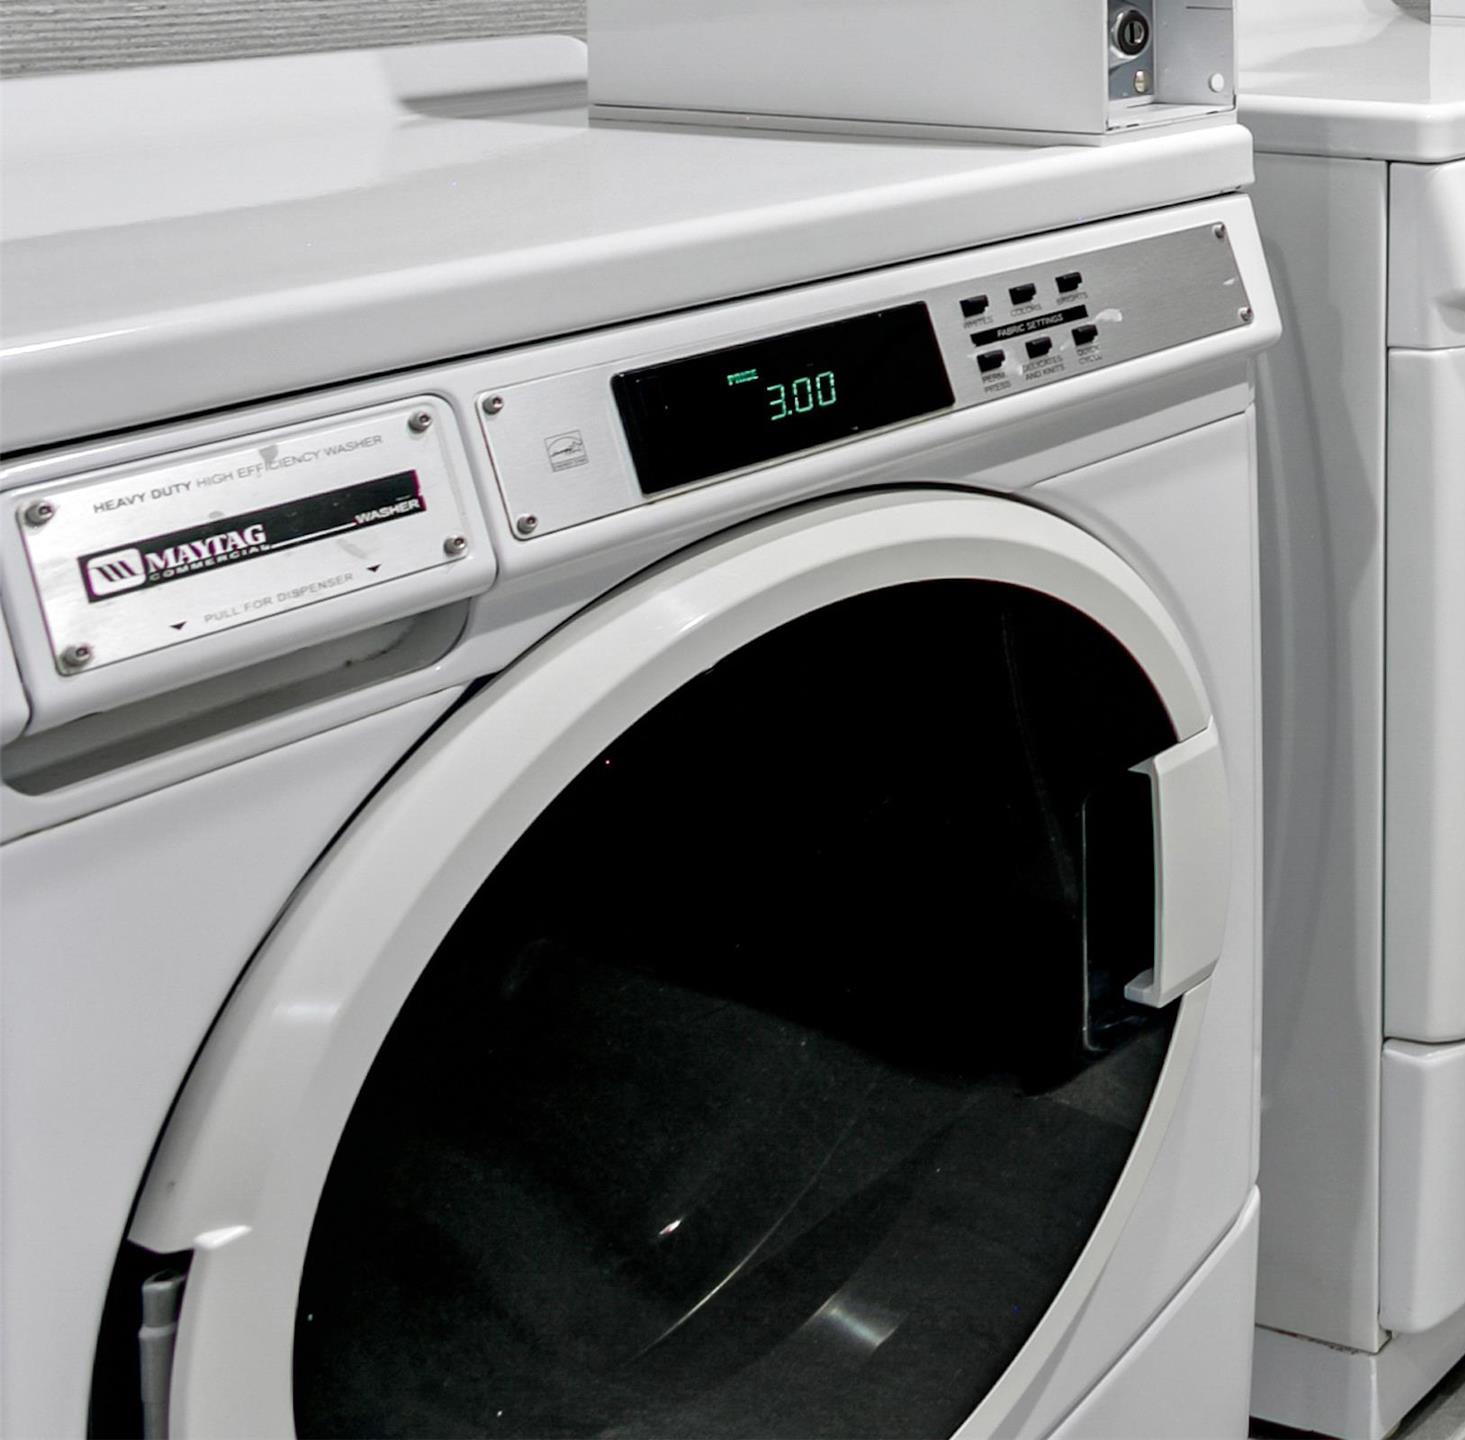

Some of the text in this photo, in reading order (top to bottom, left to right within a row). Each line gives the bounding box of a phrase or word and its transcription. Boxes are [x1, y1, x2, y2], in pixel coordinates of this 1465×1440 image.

[997, 313, 1064, 337] FABRIC SETTINGS
[767, 371, 837, 420] 3.00
[93, 434, 383, 514] HEAVY DUTY HIGH EFFICIENCY WASHER
[355, 497, 420, 525] WASHER
[147, 523, 266, 573] MAYTAG
[149, 543, 272, 582] COMMERCIAL
[204, 573, 354, 624] PULL FOR DISPENSER
